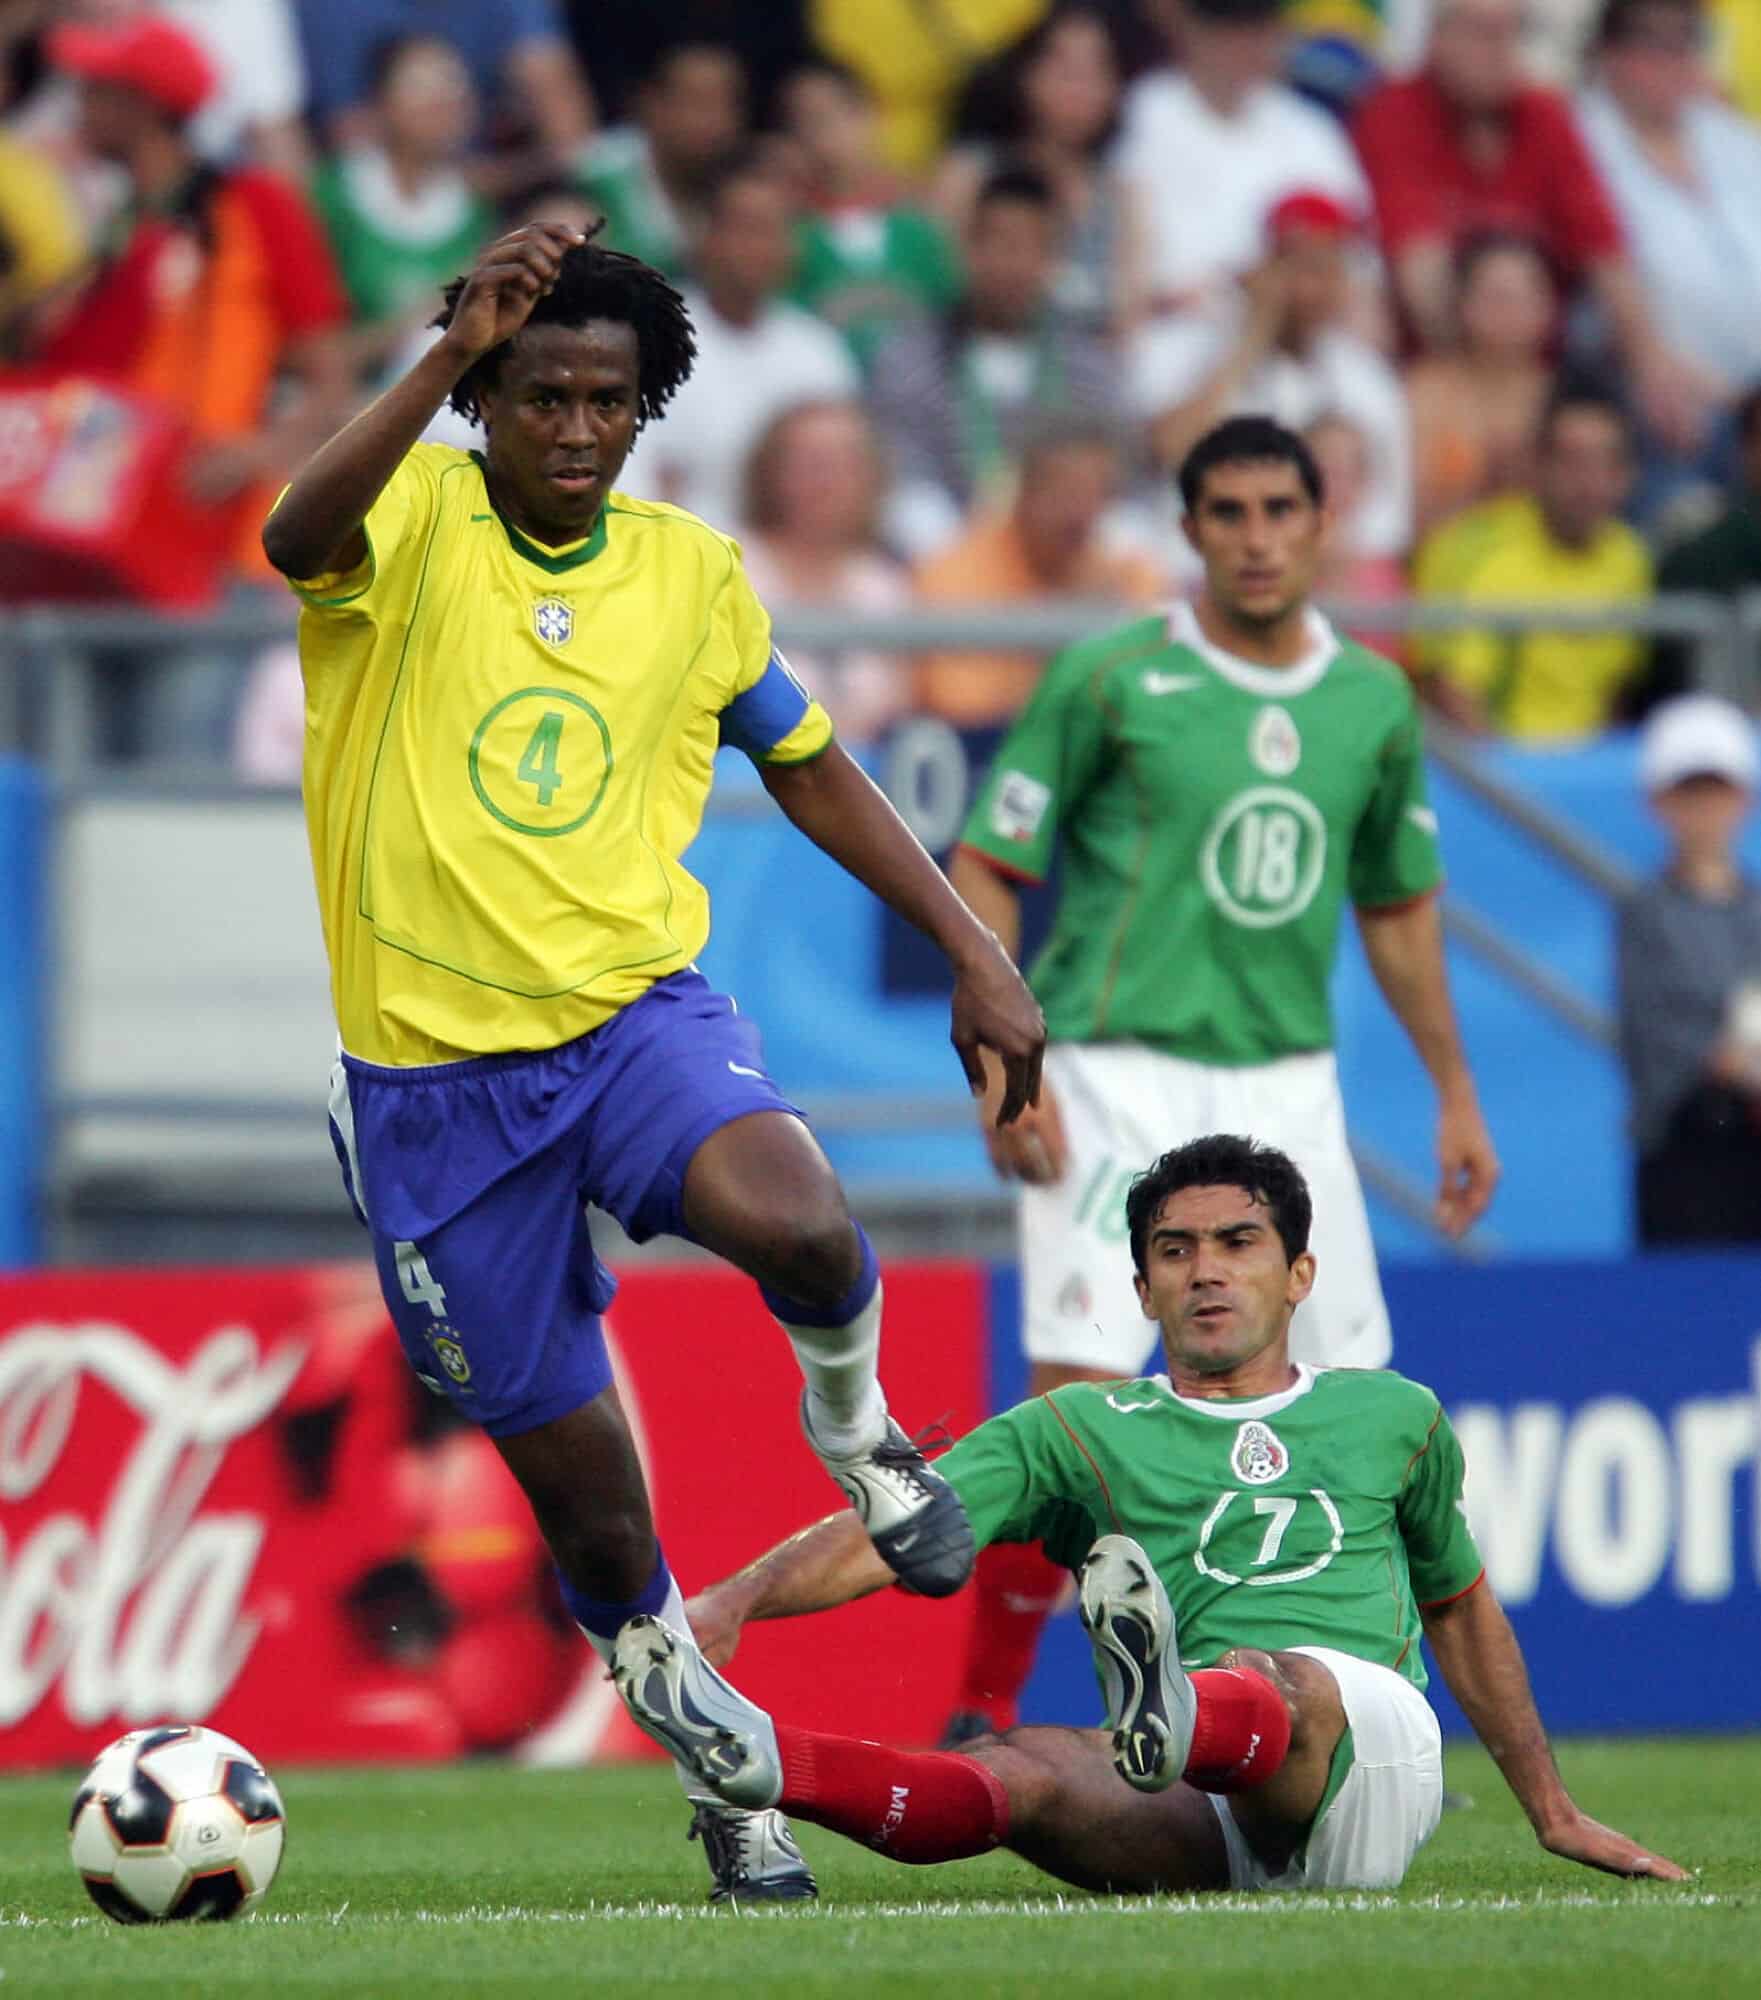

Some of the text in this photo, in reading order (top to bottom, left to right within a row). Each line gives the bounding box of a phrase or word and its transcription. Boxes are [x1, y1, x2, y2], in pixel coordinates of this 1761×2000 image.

[518, 711, 564, 806] 4
[1236, 810, 1299, 903] 18
[393, 1240, 447, 1318] 4
[1452, 1340, 1761, 1608] wor
[1250, 1497, 1298, 1566] 7
